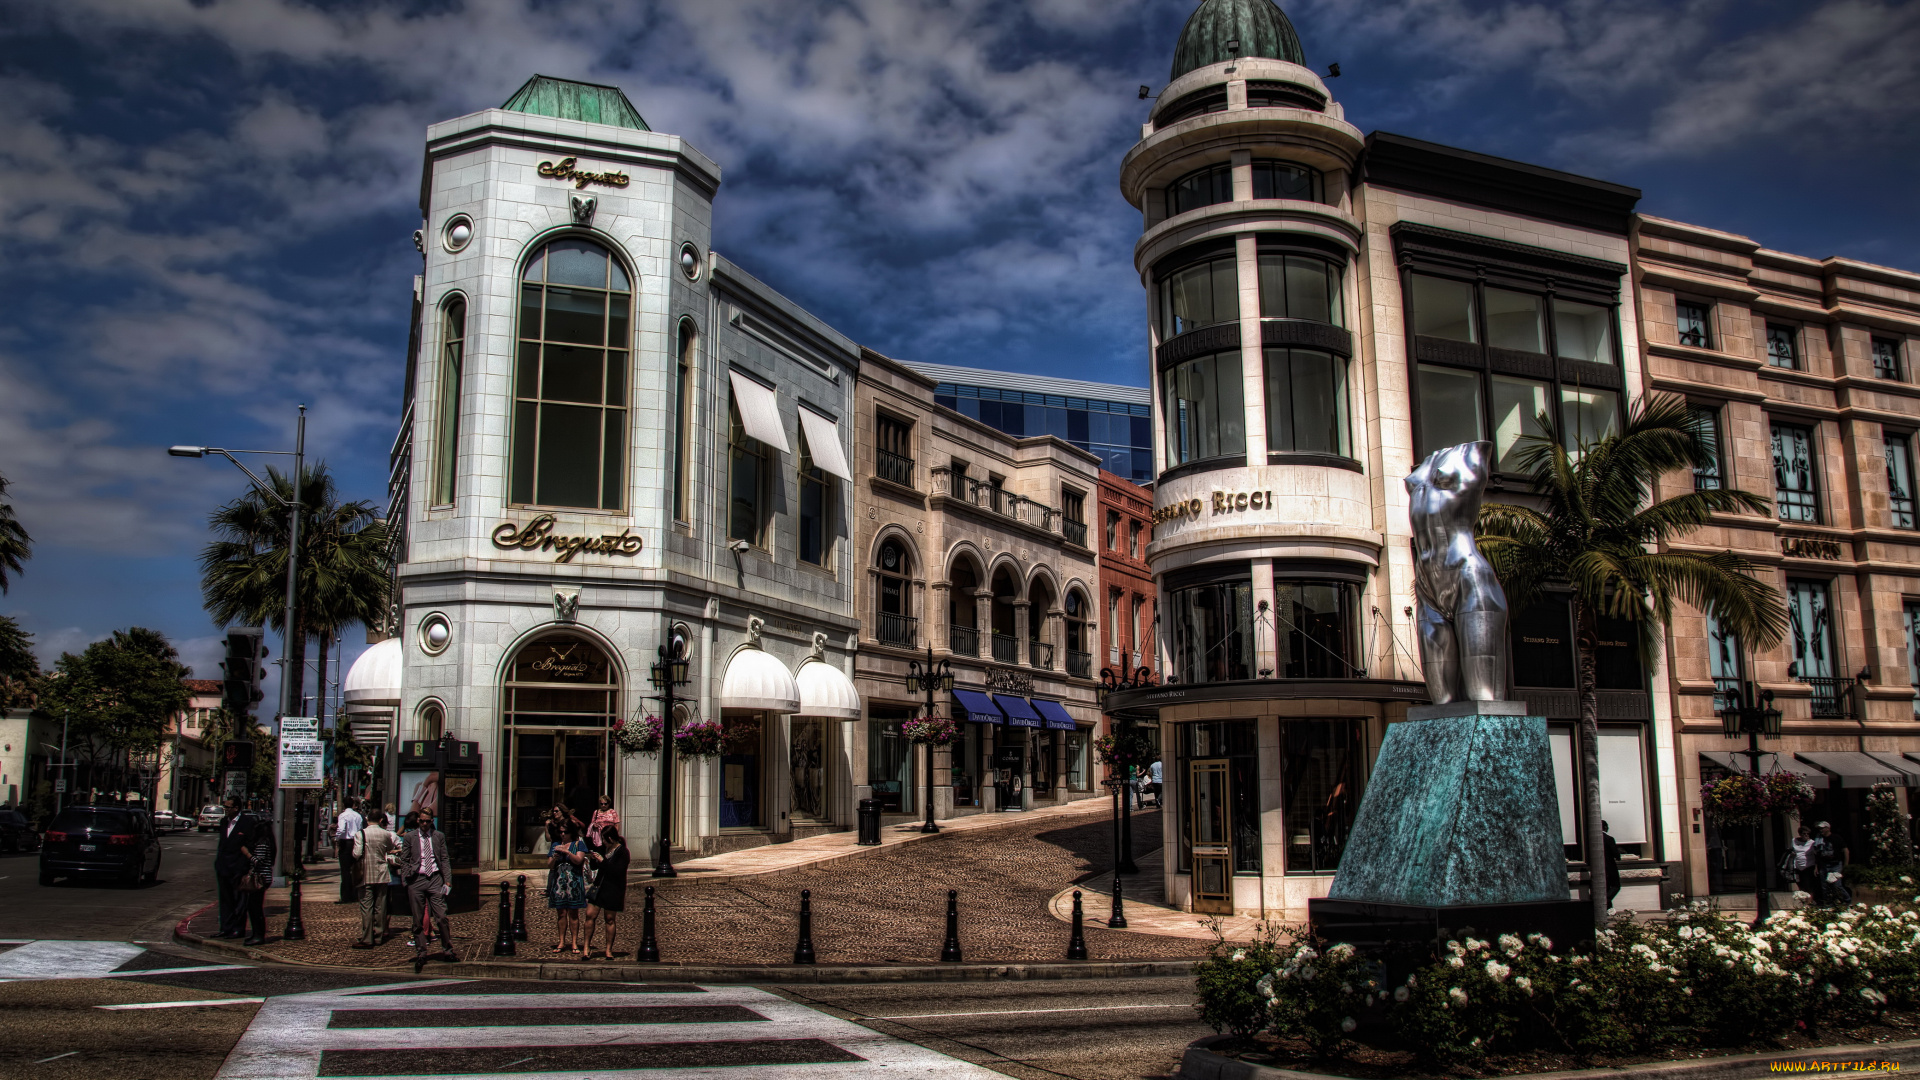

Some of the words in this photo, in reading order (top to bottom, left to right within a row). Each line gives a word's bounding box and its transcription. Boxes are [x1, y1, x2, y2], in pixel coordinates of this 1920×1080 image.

[537, 156, 629, 189] Breguet
[1212, 490, 1272, 511] RICCI
[492, 513, 642, 563] Breguet
[1781, 538, 1842, 559] LANVIN
[883, 586, 899, 596] ERSACE
[532, 657, 587, 676] Breguet
[1168, 690, 1185, 698] RICCI
